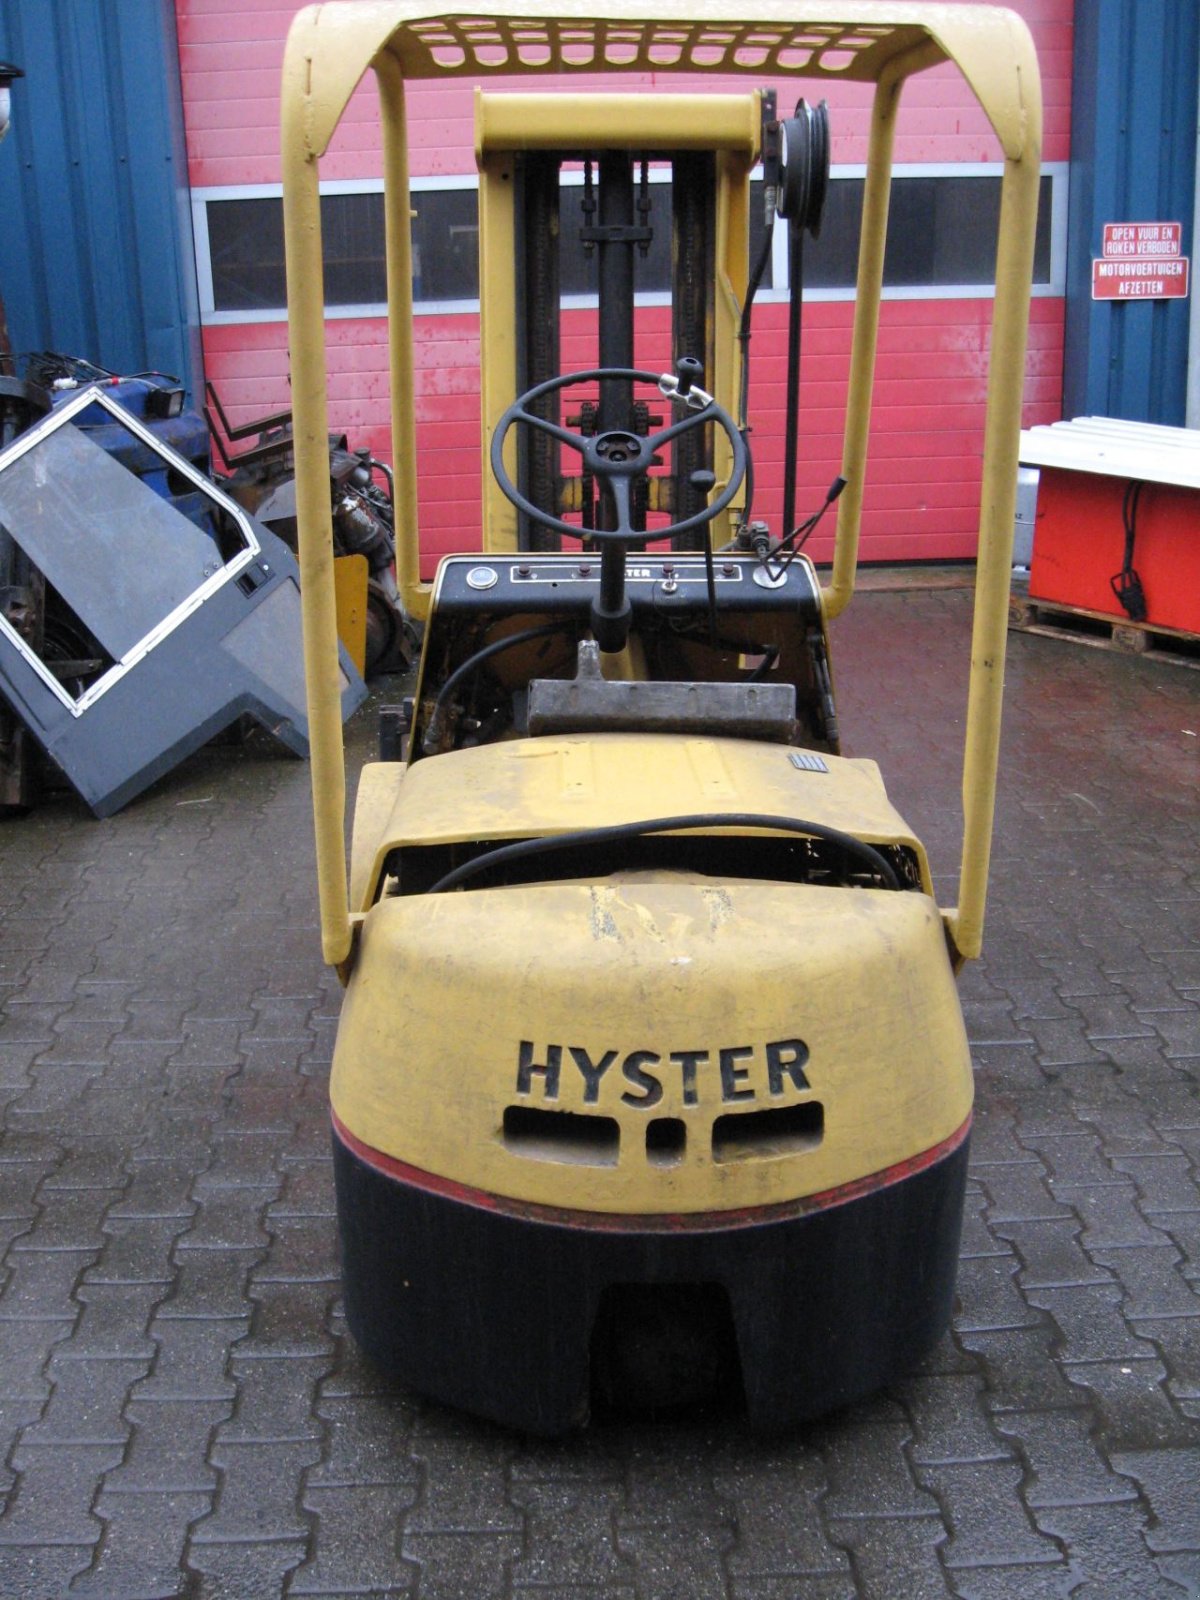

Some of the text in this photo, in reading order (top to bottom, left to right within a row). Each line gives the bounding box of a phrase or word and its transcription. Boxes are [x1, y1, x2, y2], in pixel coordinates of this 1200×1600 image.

[1112, 226, 1173, 240] OPEN VUUR EN
[1106, 241, 1178, 254] ROKEN VERBODEN
[1099, 262, 1183, 276] MOTORVOERTUIGEN
[1118, 281, 1163, 294] AFZETTEN
[624, 569, 650, 577] TER
[515, 1038, 812, 1109] HYSTER
